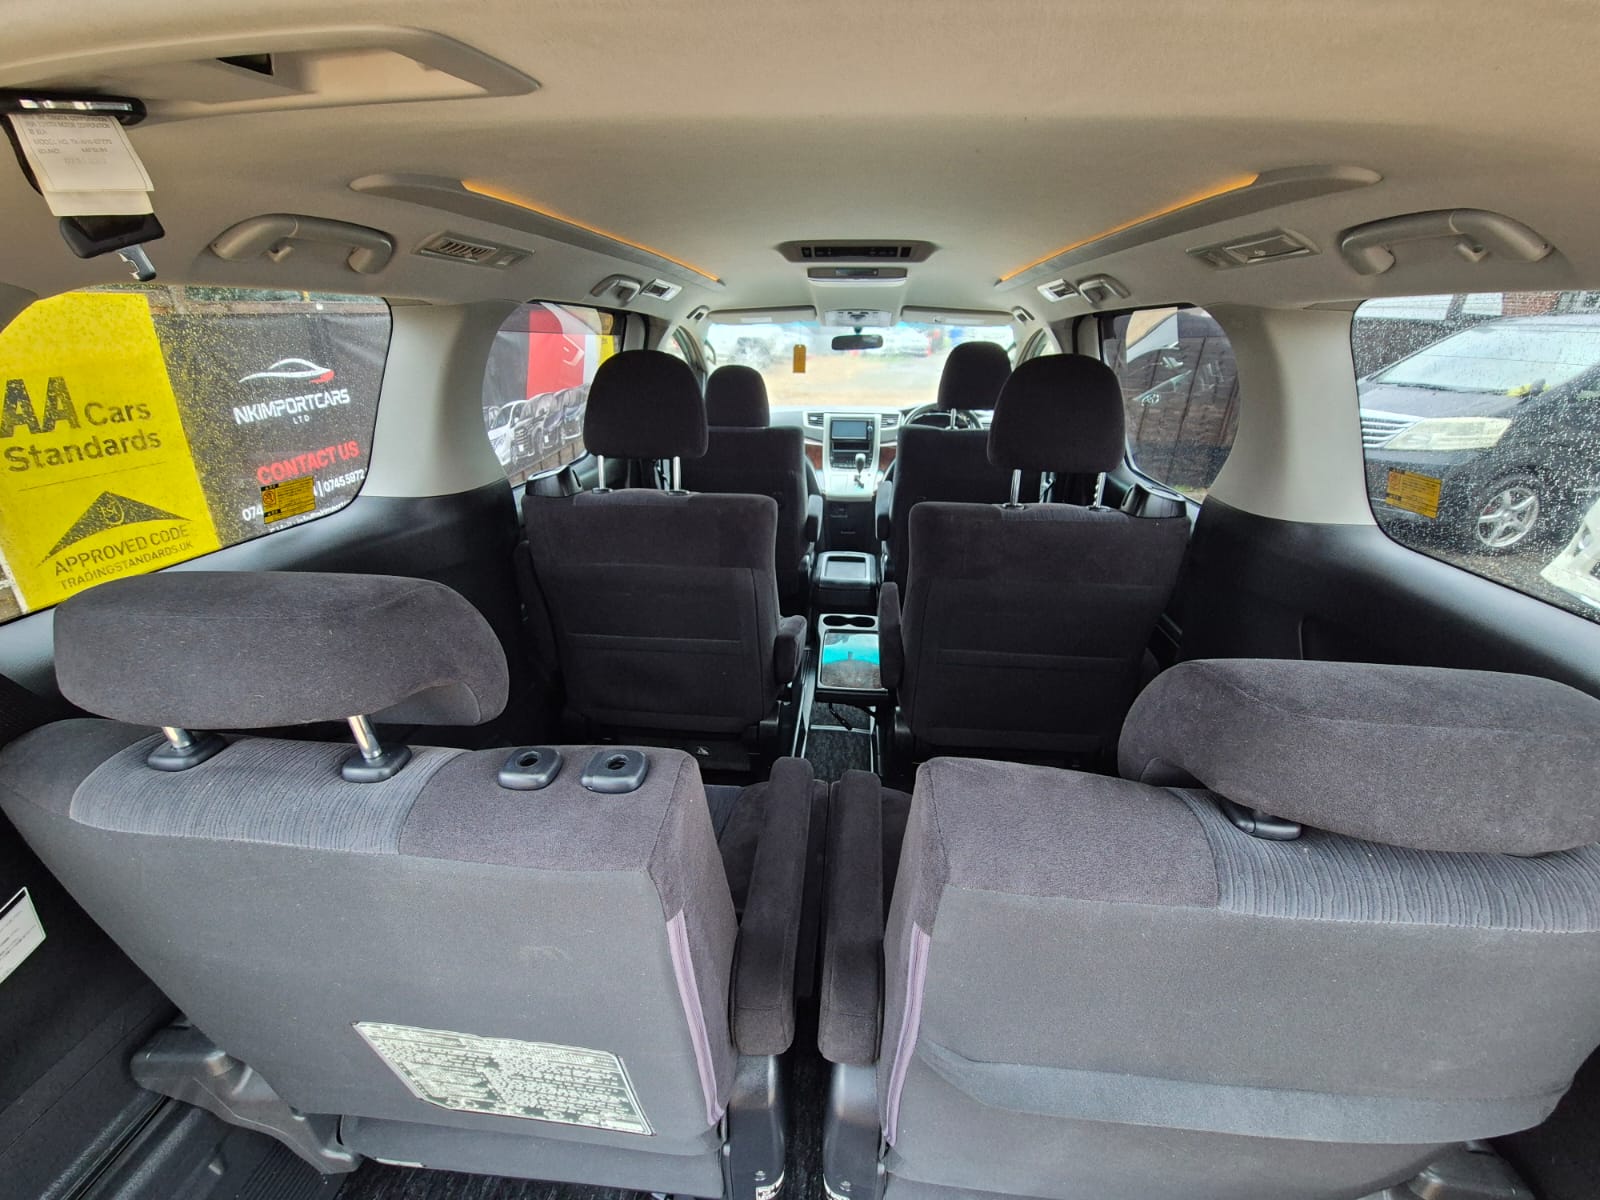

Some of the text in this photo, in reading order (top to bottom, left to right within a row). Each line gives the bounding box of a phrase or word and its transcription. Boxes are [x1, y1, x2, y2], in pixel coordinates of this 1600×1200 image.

[0, 376, 152, 438] AA Cars
[232, 389, 350, 425] NKIMPORTCARS
[292, 414, 310, 425] LTD
[3, 428, 162, 473] Standards
[256, 440, 360, 485] CONTACT US
[55, 521, 193, 577] APPROVED CODE
[60, 540, 194, 590] TRADINGSTANDARDS.UK
